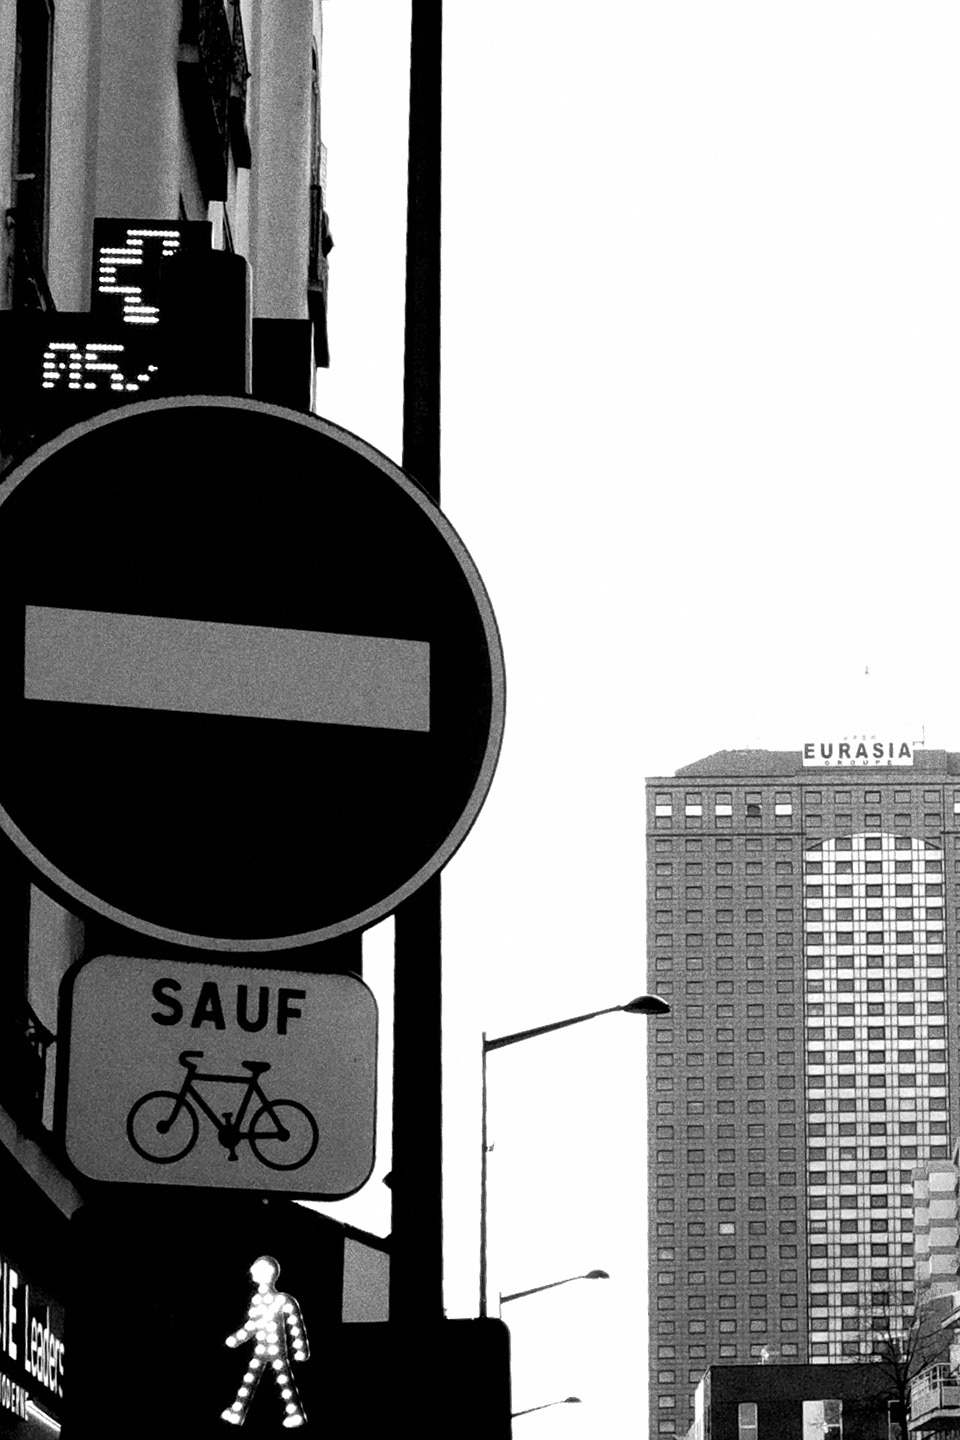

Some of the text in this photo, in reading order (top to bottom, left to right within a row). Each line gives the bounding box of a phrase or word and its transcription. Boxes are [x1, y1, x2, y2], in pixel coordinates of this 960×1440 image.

[804, 742, 911, 760] EURASIA
[825, 759, 892, 767] GROUPE
[151, 978, 307, 1036] SAUF
[0, 1254, 18, 1361] IE
